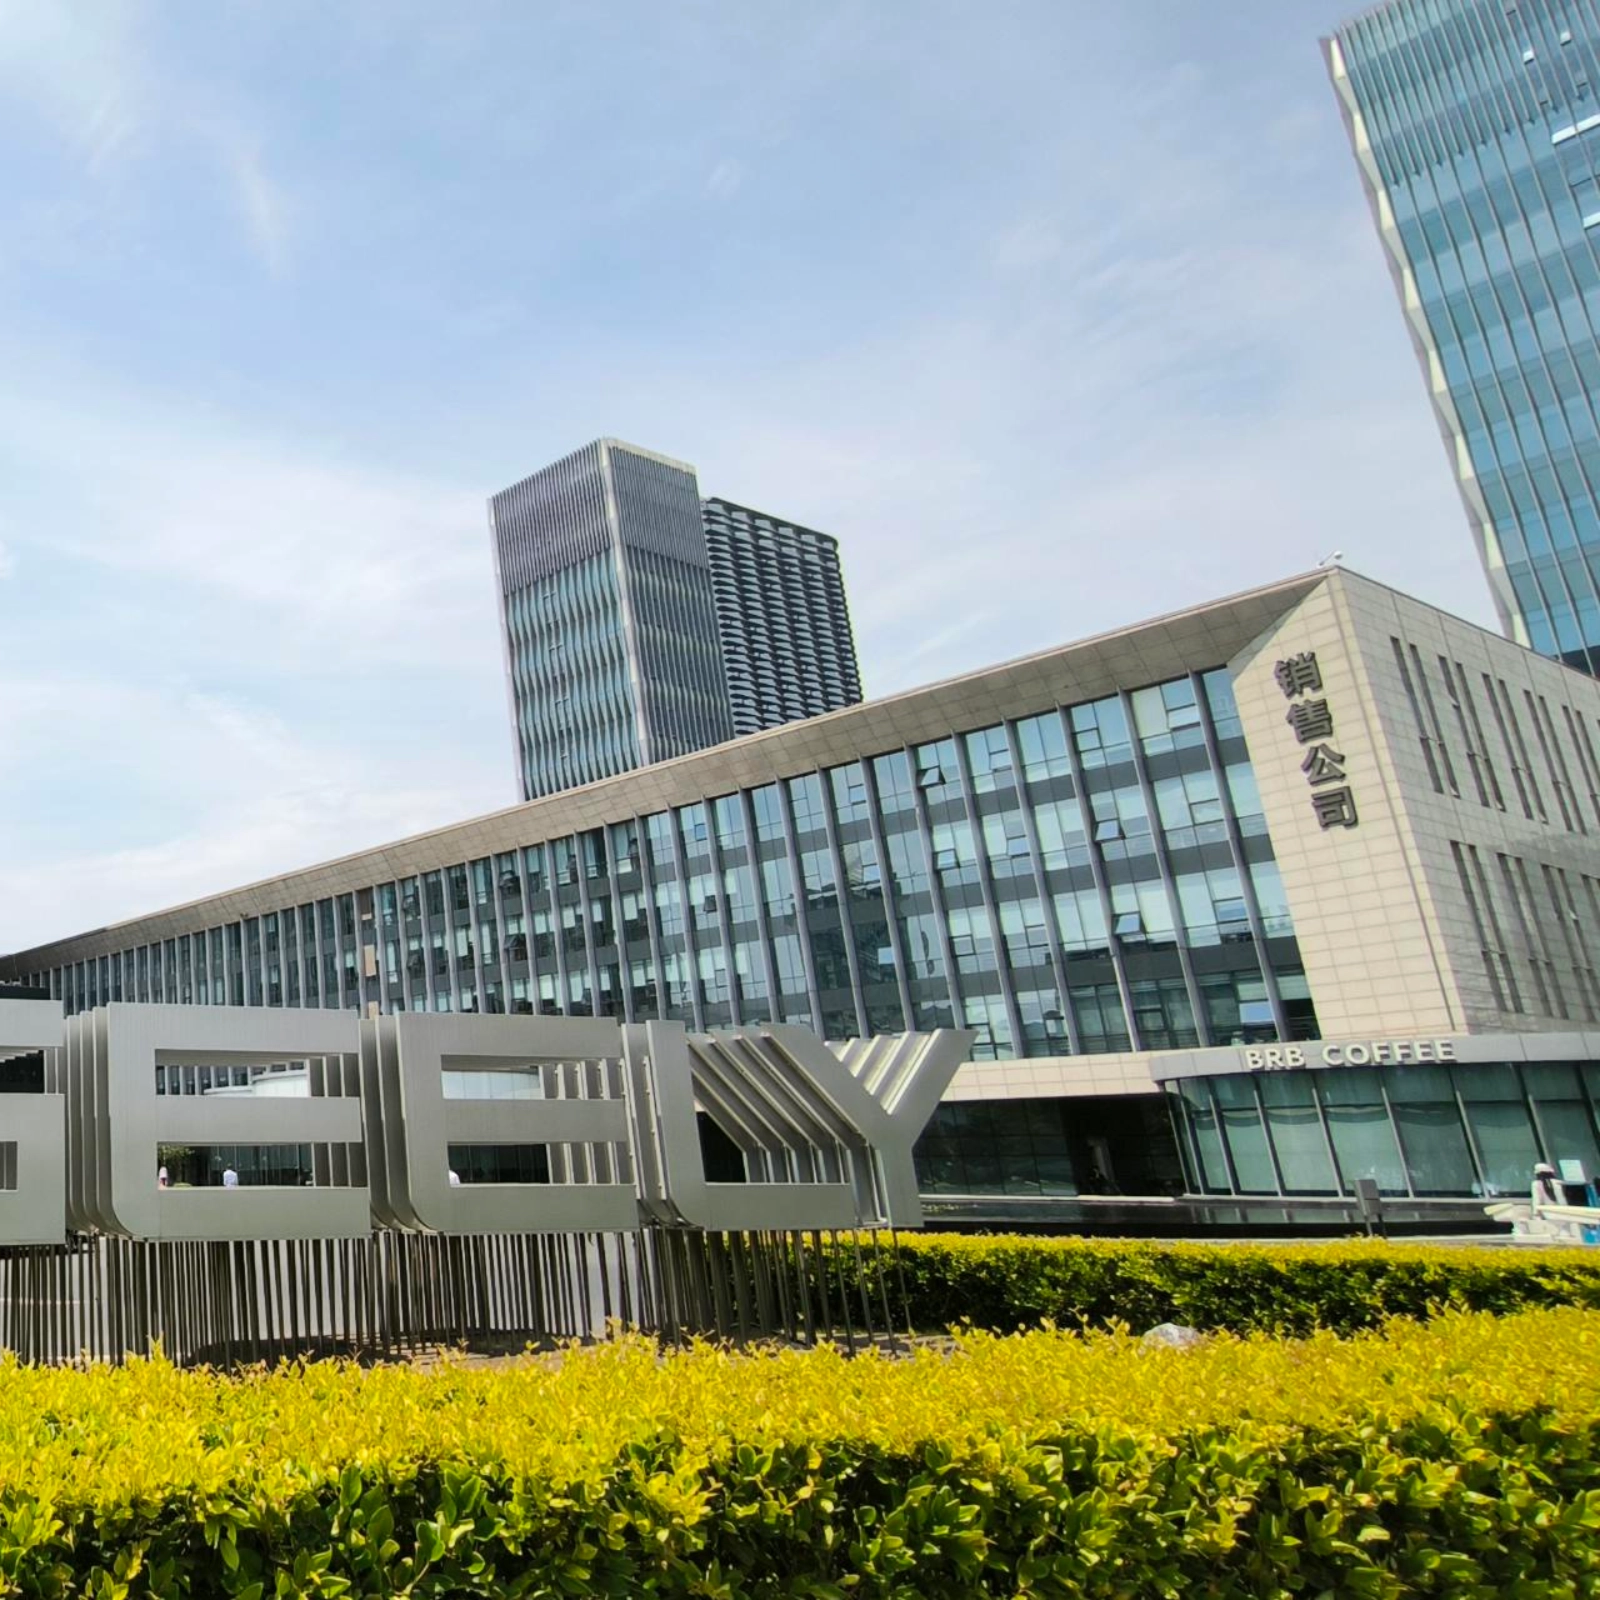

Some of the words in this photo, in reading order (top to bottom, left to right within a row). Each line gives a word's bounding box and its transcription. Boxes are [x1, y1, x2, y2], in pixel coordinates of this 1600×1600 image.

[1274, 651, 1359, 830] 销售公司
[1245, 1047, 1305, 1070] BRB
[1322, 1039, 1456, 1066] COFFEE
